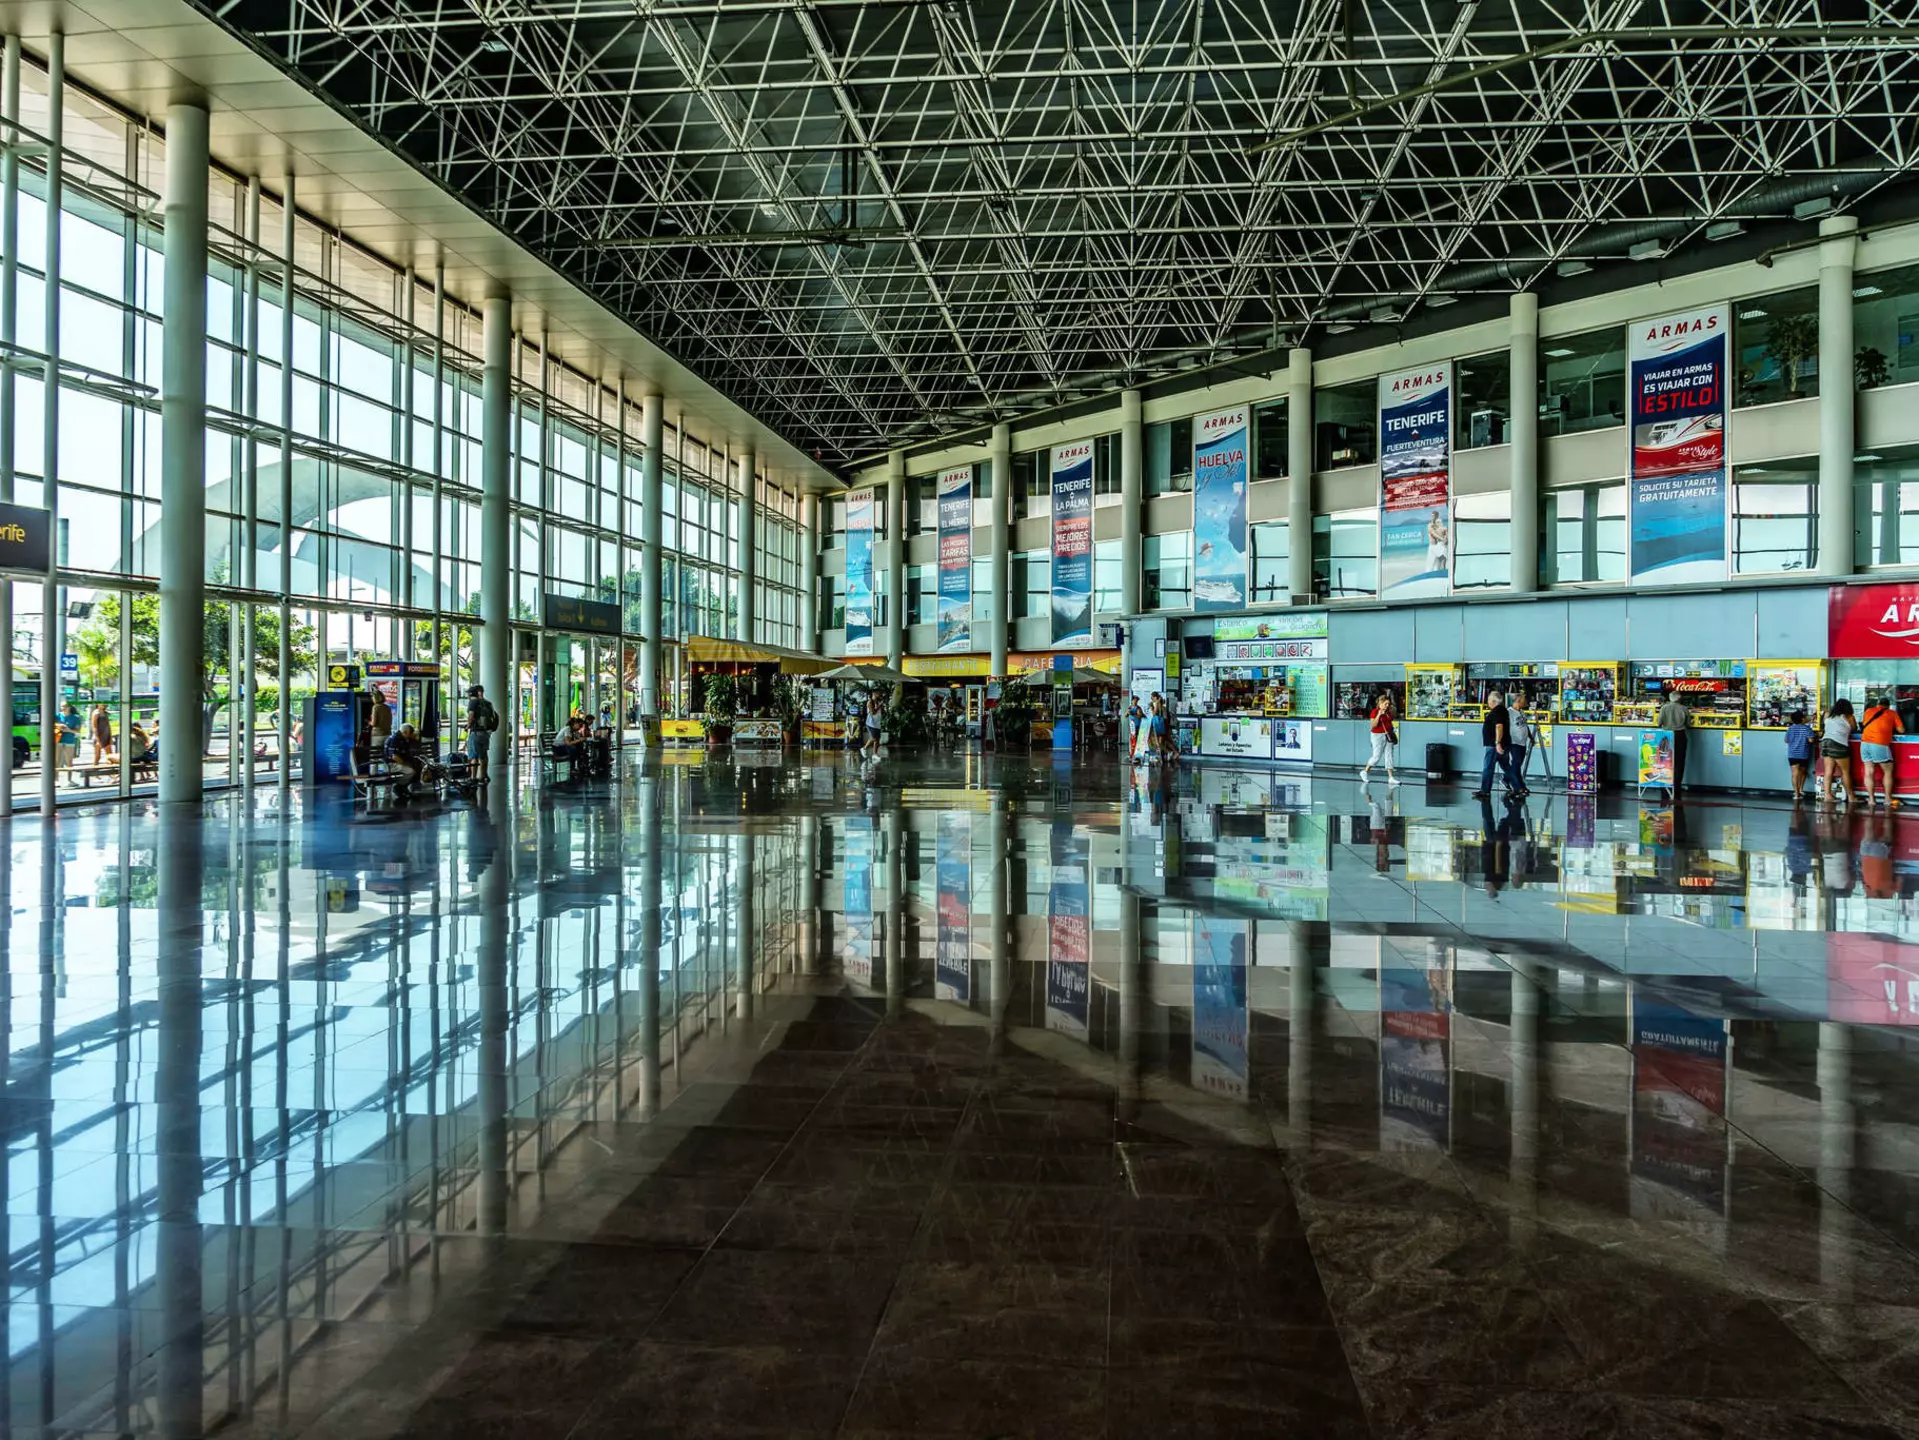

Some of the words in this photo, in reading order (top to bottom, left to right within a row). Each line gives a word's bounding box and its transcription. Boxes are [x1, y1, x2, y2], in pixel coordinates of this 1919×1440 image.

[1646, 315, 1718, 340] ARMAS
[1643, 370, 1671, 381] VIAJAR
[1671, 367, 1683, 377] EN
[1683, 362, 1713, 375] ARMAS
[1392, 371, 1444, 392] ARMAS
[1643, 383, 1656, 394] ES
[1657, 378, 1691, 391] VIAJAR
[1692, 373, 1713, 386] CON
[1644, 387, 1713, 413] ESTILO
[1203, 413, 1243, 430] ARMAS
[1386, 410, 1445, 432] TENERIFE
[1386, 436, 1445, 452] FUERTEVENTURA
[1059, 445, 1090, 460] ARMAS
[1198, 449, 1244, 468] HUELVA
[944, 471, 969, 483] ARMAS
[1639, 481, 1671, 492] SOLICITE
[1672, 479, 1683, 489] SU
[1684, 477, 1718, 488] TARJETA
[1053, 478, 1091, 494] TENERIFE
[851, 491, 871, 502] ARMAS
[1639, 486, 1718, 503] GRATUITAMENTE
[940, 499, 970, 513] TENERIFE
[1055, 501, 1065, 511] LA
[1065, 497, 1090, 509] PALMA
[1056, 530, 1089, 542] MEJORES
[1057, 541, 1086, 552] PRECIOS
[62, 657, 77, 668] 39
[1024, 656, 1093, 670] CAFERIA
